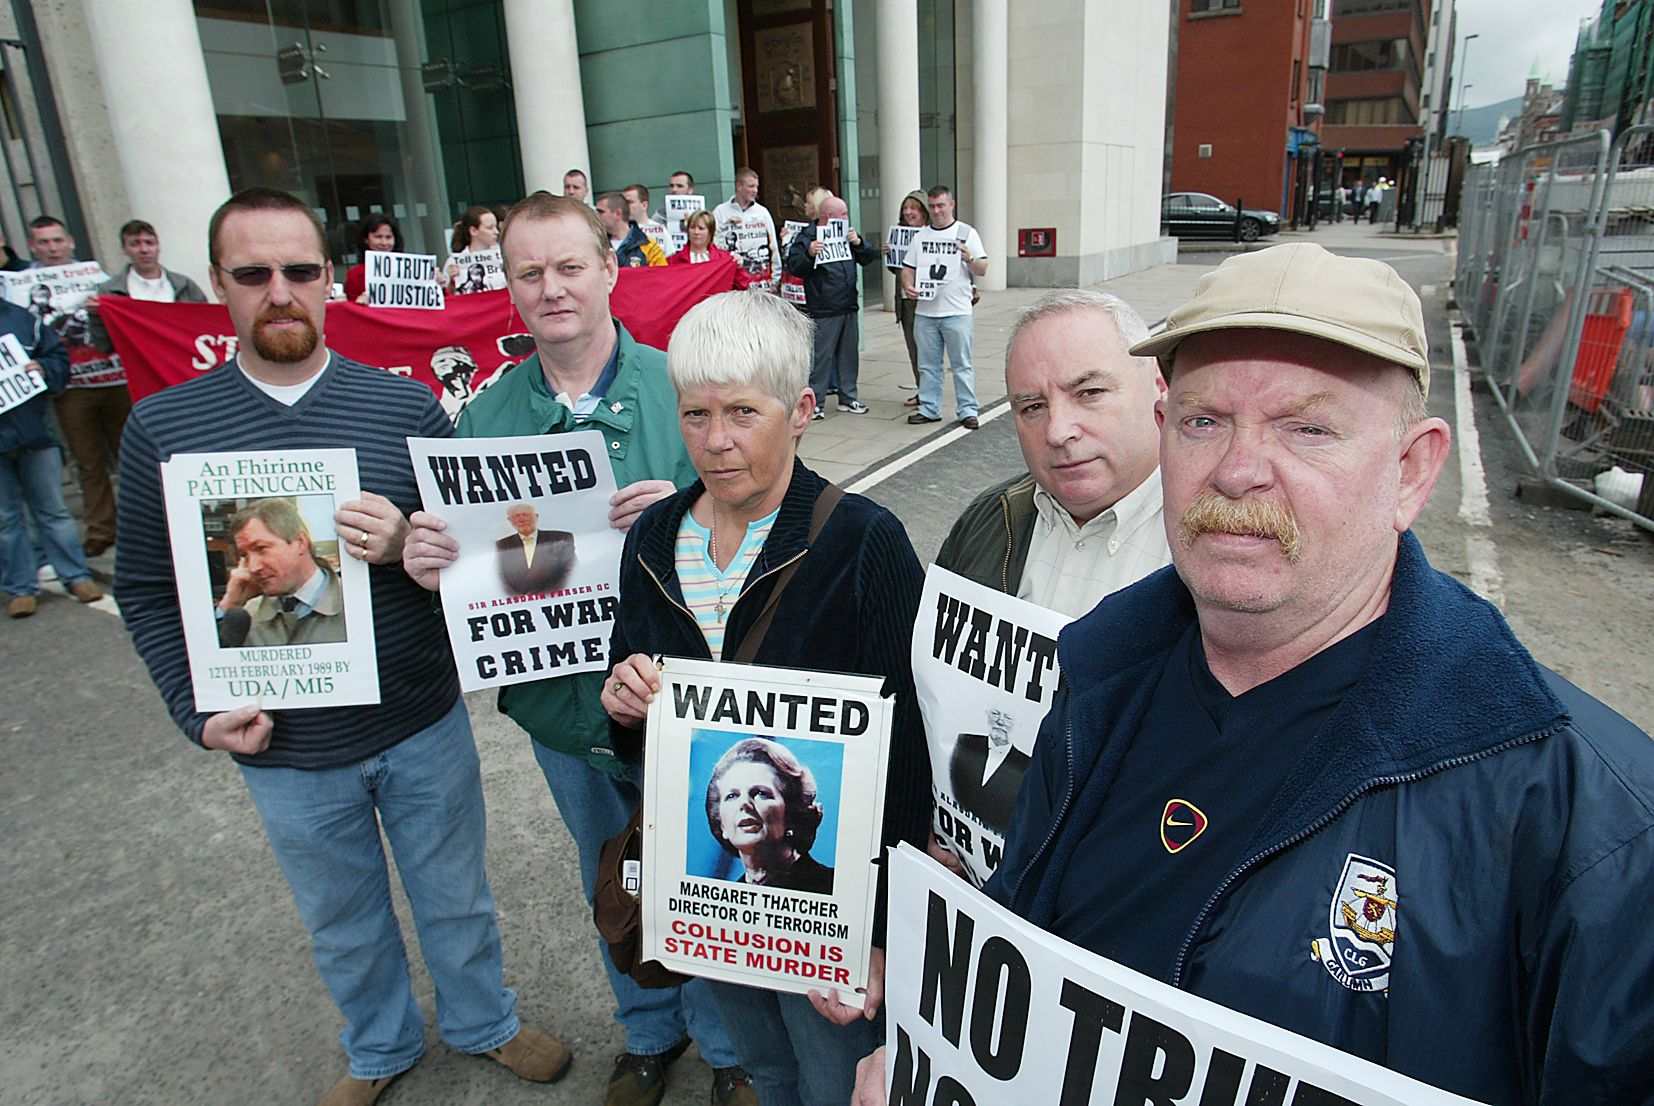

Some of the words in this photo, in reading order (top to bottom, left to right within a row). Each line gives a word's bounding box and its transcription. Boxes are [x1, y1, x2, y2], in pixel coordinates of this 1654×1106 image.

[738, 231, 767, 240] Britain
[823, 221, 843, 239] UTH
[454, 256, 472, 265] Tell
[474, 253, 492, 263] the
[818, 242, 849, 261] USTICE
[922, 242, 957, 254] WANTED
[36, 273, 58, 281] the
[374, 255, 391, 278] NO
[369, 283, 386, 304] NO
[390, 284, 440, 306] JUSTICE
[200, 461, 230, 477] An
[237, 458, 325, 475] Fhirinne
[428, 448, 598, 506] WANTED
[188, 479, 226, 496] PAT
[232, 475, 336, 495] FINUCANE
[468, 603, 487, 611] SIR
[492, 593, 546, 607] ALASDAIR
[550, 587, 592, 599] FRASER
[467, 609, 537, 643] FOR
[541, 596, 619, 630] WAR
[240, 648, 312, 662] MURDERED
[476, 637, 605, 680] CRIME
[932, 591, 1060, 704] WANT
[209, 666, 238, 679] 12TH
[241, 664, 306, 678] FEBRUARY
[308, 662, 332, 675] 1989
[335, 661, 351, 673] BY
[672, 682, 870, 736] WANTED
[932, 800, 974, 856] OR
[680, 881, 758, 907] MARGARET
[762, 894, 839, 919] THATCHER
[668, 898, 738, 923] DIRECTOR
[742, 909, 761, 925] OF
[765, 913, 849, 940] TERRORISM
[672, 920, 811, 957] COLLUSION
[819, 944, 844, 963] IS
[664, 937, 738, 965] STATE
[746, 951, 850, 985] MURDER
[1344, 948, 1368, 967] CLG
[919, 889, 1032, 1081] NO
